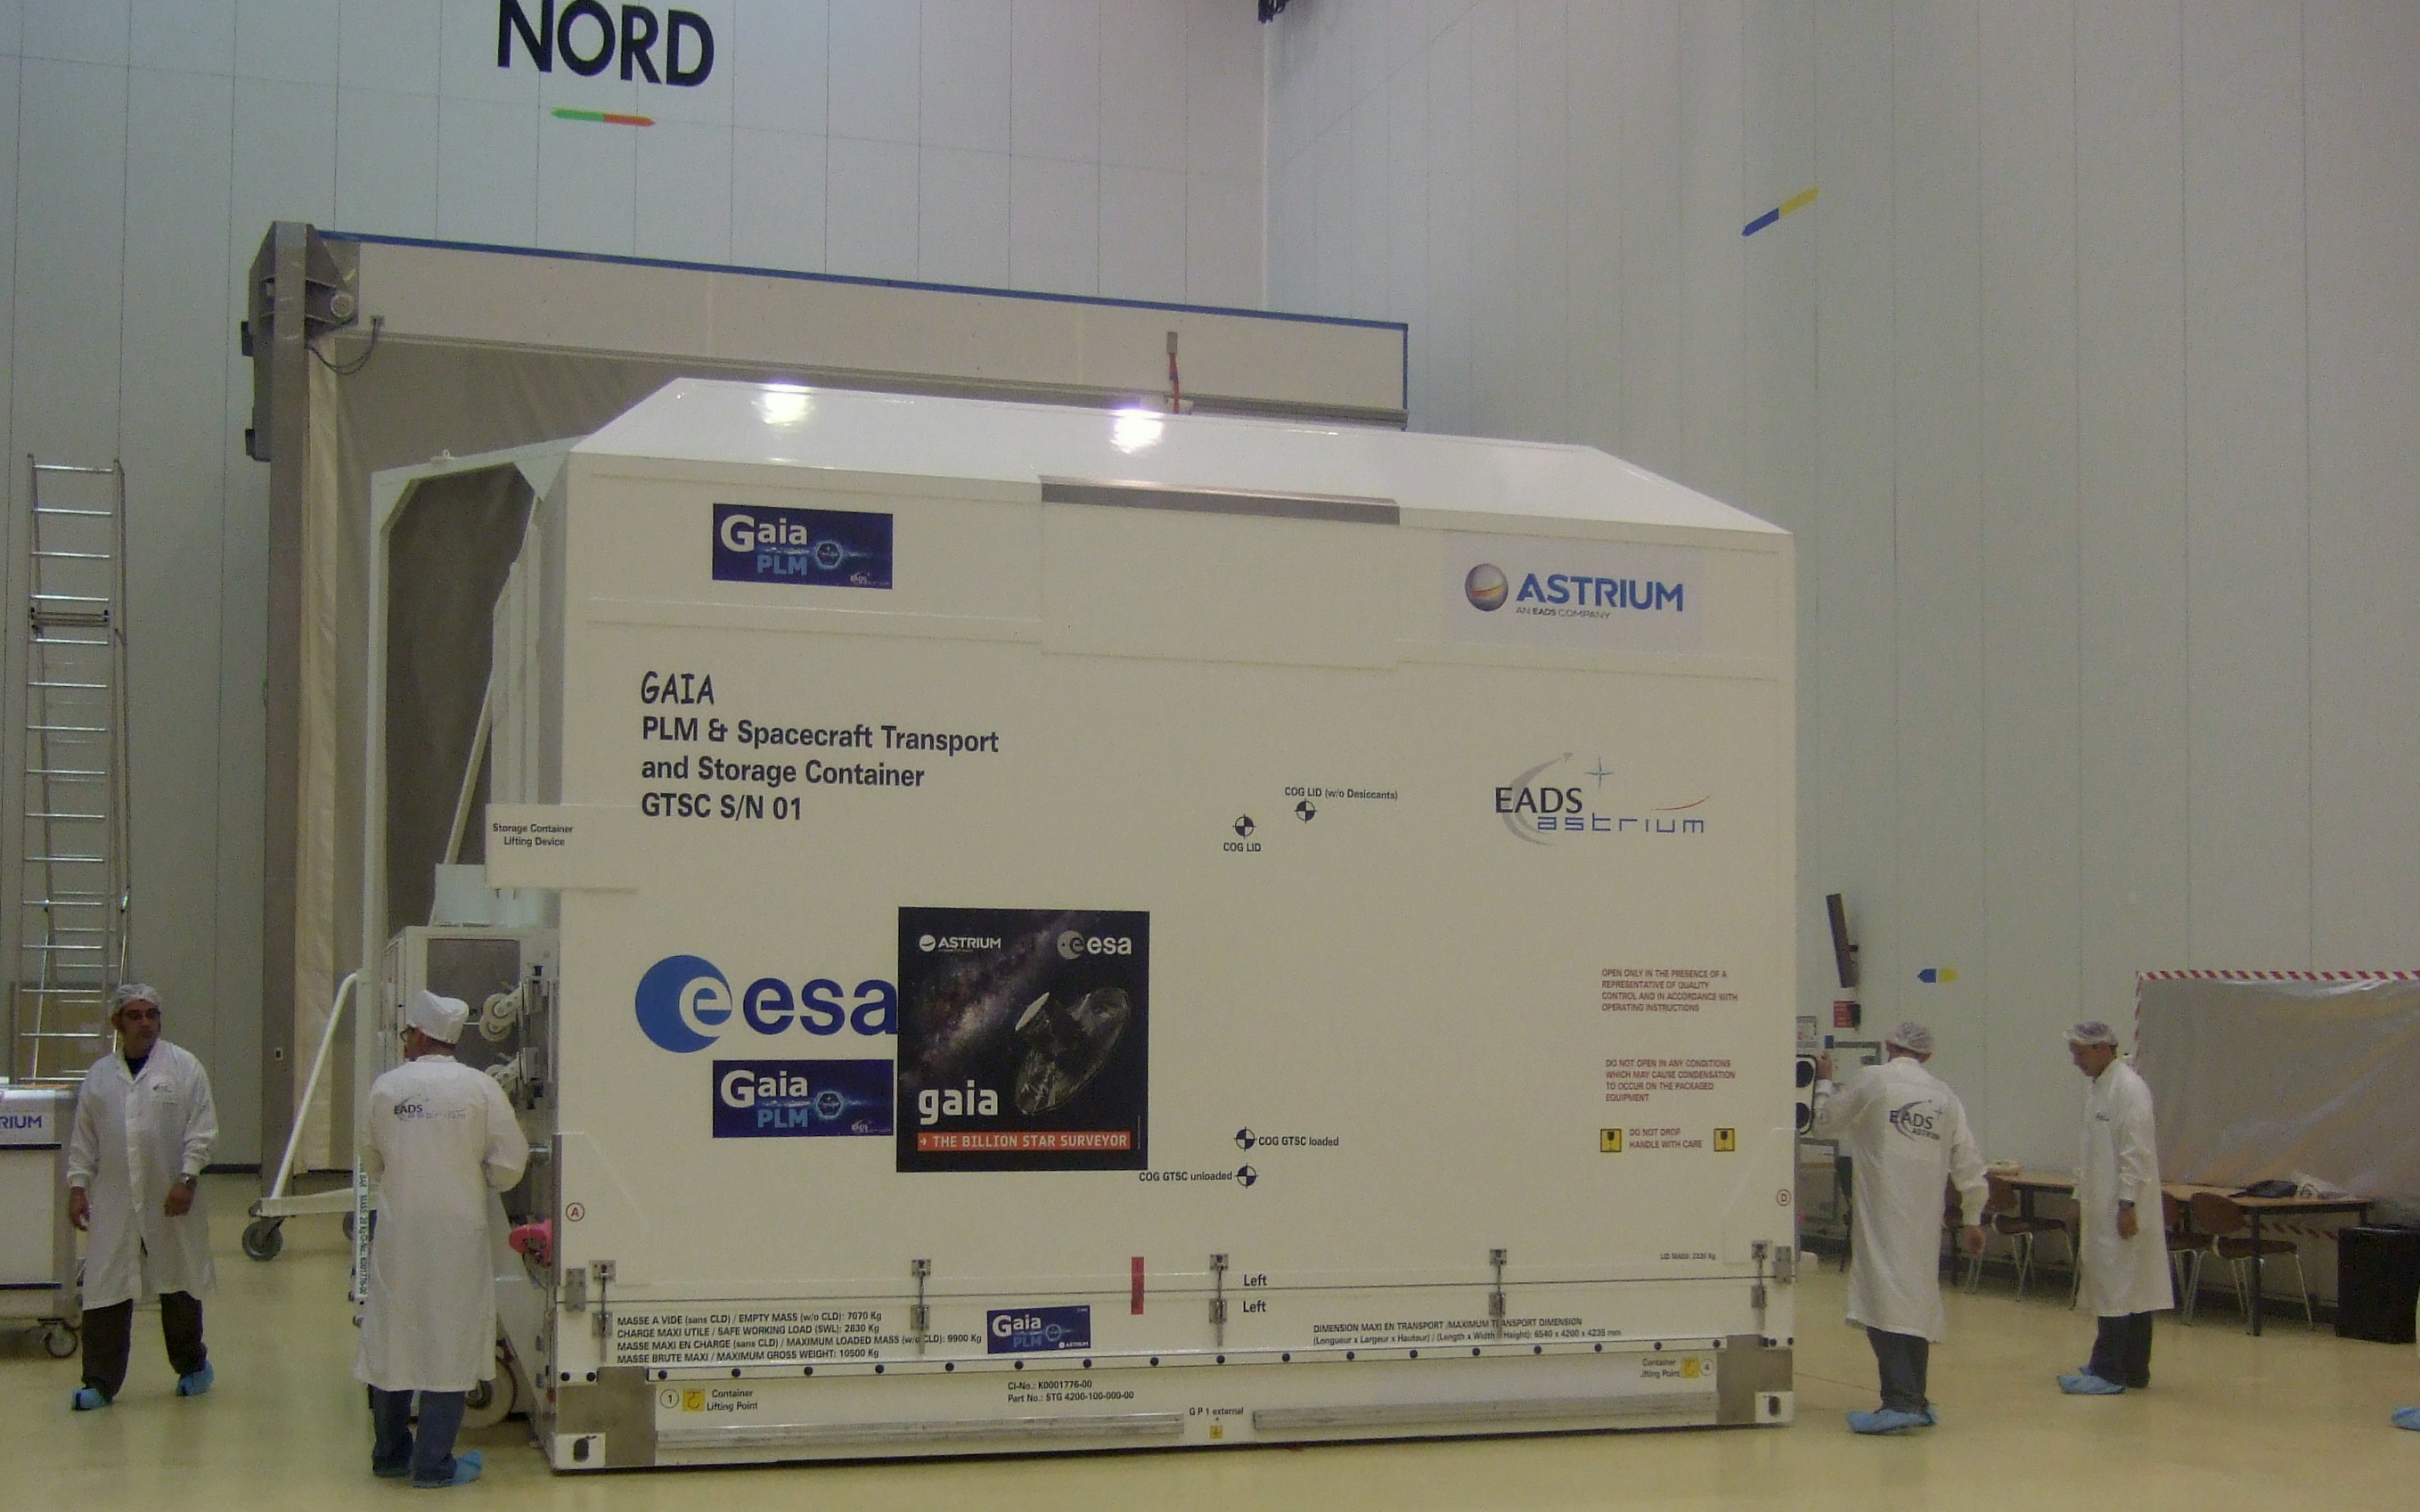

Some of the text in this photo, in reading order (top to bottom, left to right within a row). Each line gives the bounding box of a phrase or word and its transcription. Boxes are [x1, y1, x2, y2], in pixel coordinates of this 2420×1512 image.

[497, 0, 715, 87] NORD
[720, 514, 808, 553] Gaia
[757, 554, 807, 576] PLM
[1516, 573, 1683, 612] ASTRIUM
[1516, 607, 1611, 620] AN EADS COMPANY
[641, 671, 715, 706] GAIA
[642, 715, 999, 757] PLM & Spacecraft Transport
[642, 755, 925, 788] and Storage Container
[1284, 786, 1398, 801] COG LID (w/o Desiccants)
[642, 792, 802, 821] GTSC S/N 01
[1494, 787, 1582, 814] EADS
[493, 822, 574, 835] Storage Container
[1537, 812, 1704, 834] astrium
[503, 837, 565, 847] Lifting Device
[1223, 842, 1262, 853] COG LID
[937, 936, 1002, 950] ASTRIUM
[1086, 936, 1132, 955] esa
[1602, 968, 1727, 978] OPEN ONLY IN THE PRESENCE OF A
[1602, 980, 1709, 989] REPRESENTATIVE OF QUALITY
[1602, 992, 1737, 1001] CONTROL AND IN ACCORDANCE WITH
[742, 977, 898, 1036] esa
[1602, 1003, 1699, 1012] OPERATING INSTRUCTIONS
[1606, 1058, 1730, 1067] DO NOT OPEN IN ANY CONDITIONS
[1606, 1071, 1736, 1079] WHICH MAY CAUSE CONDENSATION
[720, 1069, 808, 1107] Gaia
[1606, 1082, 1714, 1090] TO OCCUR ON THE PACKAGED
[919, 1080, 999, 1125] gaia
[1606, 1093, 1649, 1102] EQUIPMENT
[394, 1104, 423, 1115] EADS
[757, 1108, 809, 1128] PLM
[1889, 1109, 1934, 1130] EADS
[933, 1135, 1127, 1148] THE BILLION STAR SURVEYOR
[1258, 1136, 1339, 1147] COG GTSC loaded
[1629, 1140, 1703, 1148] HANDLE WITH CARE
[1139, 1171, 1232, 1181] COG GTSC unloaded
[1244, 1273, 1267, 1287] Left
[1243, 1300, 1266, 1312] Left
[617, 1311, 882, 1326] MASSE VIDE (sans CLD) EMPTY MASS (w/o CLD): 7070 Kg
[1313, 1317, 1582, 1333] DIMENSION MAXI EN TRANSPORT DIMENSION
[617, 1324, 879, 1338] CHARGE MAXI UTILE SAFE WORKING LOAD (SWL): 2830 Kg
[992, 1314, 1042, 1337] Gaia
[617, 1333, 982, 1351] MASSE MAXI EN CHARGE (sans CLD) MAXIMUM LOADED MASS 9900 Kg
[1013, 1335, 1042, 1348] PLM
[1313, 1336, 1352, 1346] (Longueur
[1361, 1335, 1388, 1345] Largeur
[1397, 1334, 1430, 1343] Hauteur)
[1436, 1333, 1465, 1343] (Length
[1474, 1331, 1495, 1339] Width
[1534, 1329, 1553, 1337] 6540
[617, 1349, 879, 1363] MASSE BRUTE MAXI MAXIMUM GROSS WEIGHT: 10500 Kg
[1642, 1358, 1676, 1367] Container
[1662, 1369, 1680, 1377] Point
[1038, 1380, 1092, 1389] K0001776-00
[712, 1388, 754, 1398] Container
[1008, 1391, 1134, 1402] Part No.: STG 4200-100-000-00
[707, 1401, 758, 1412] Lifting Point
[1212, 1407, 1244, 1415] external
